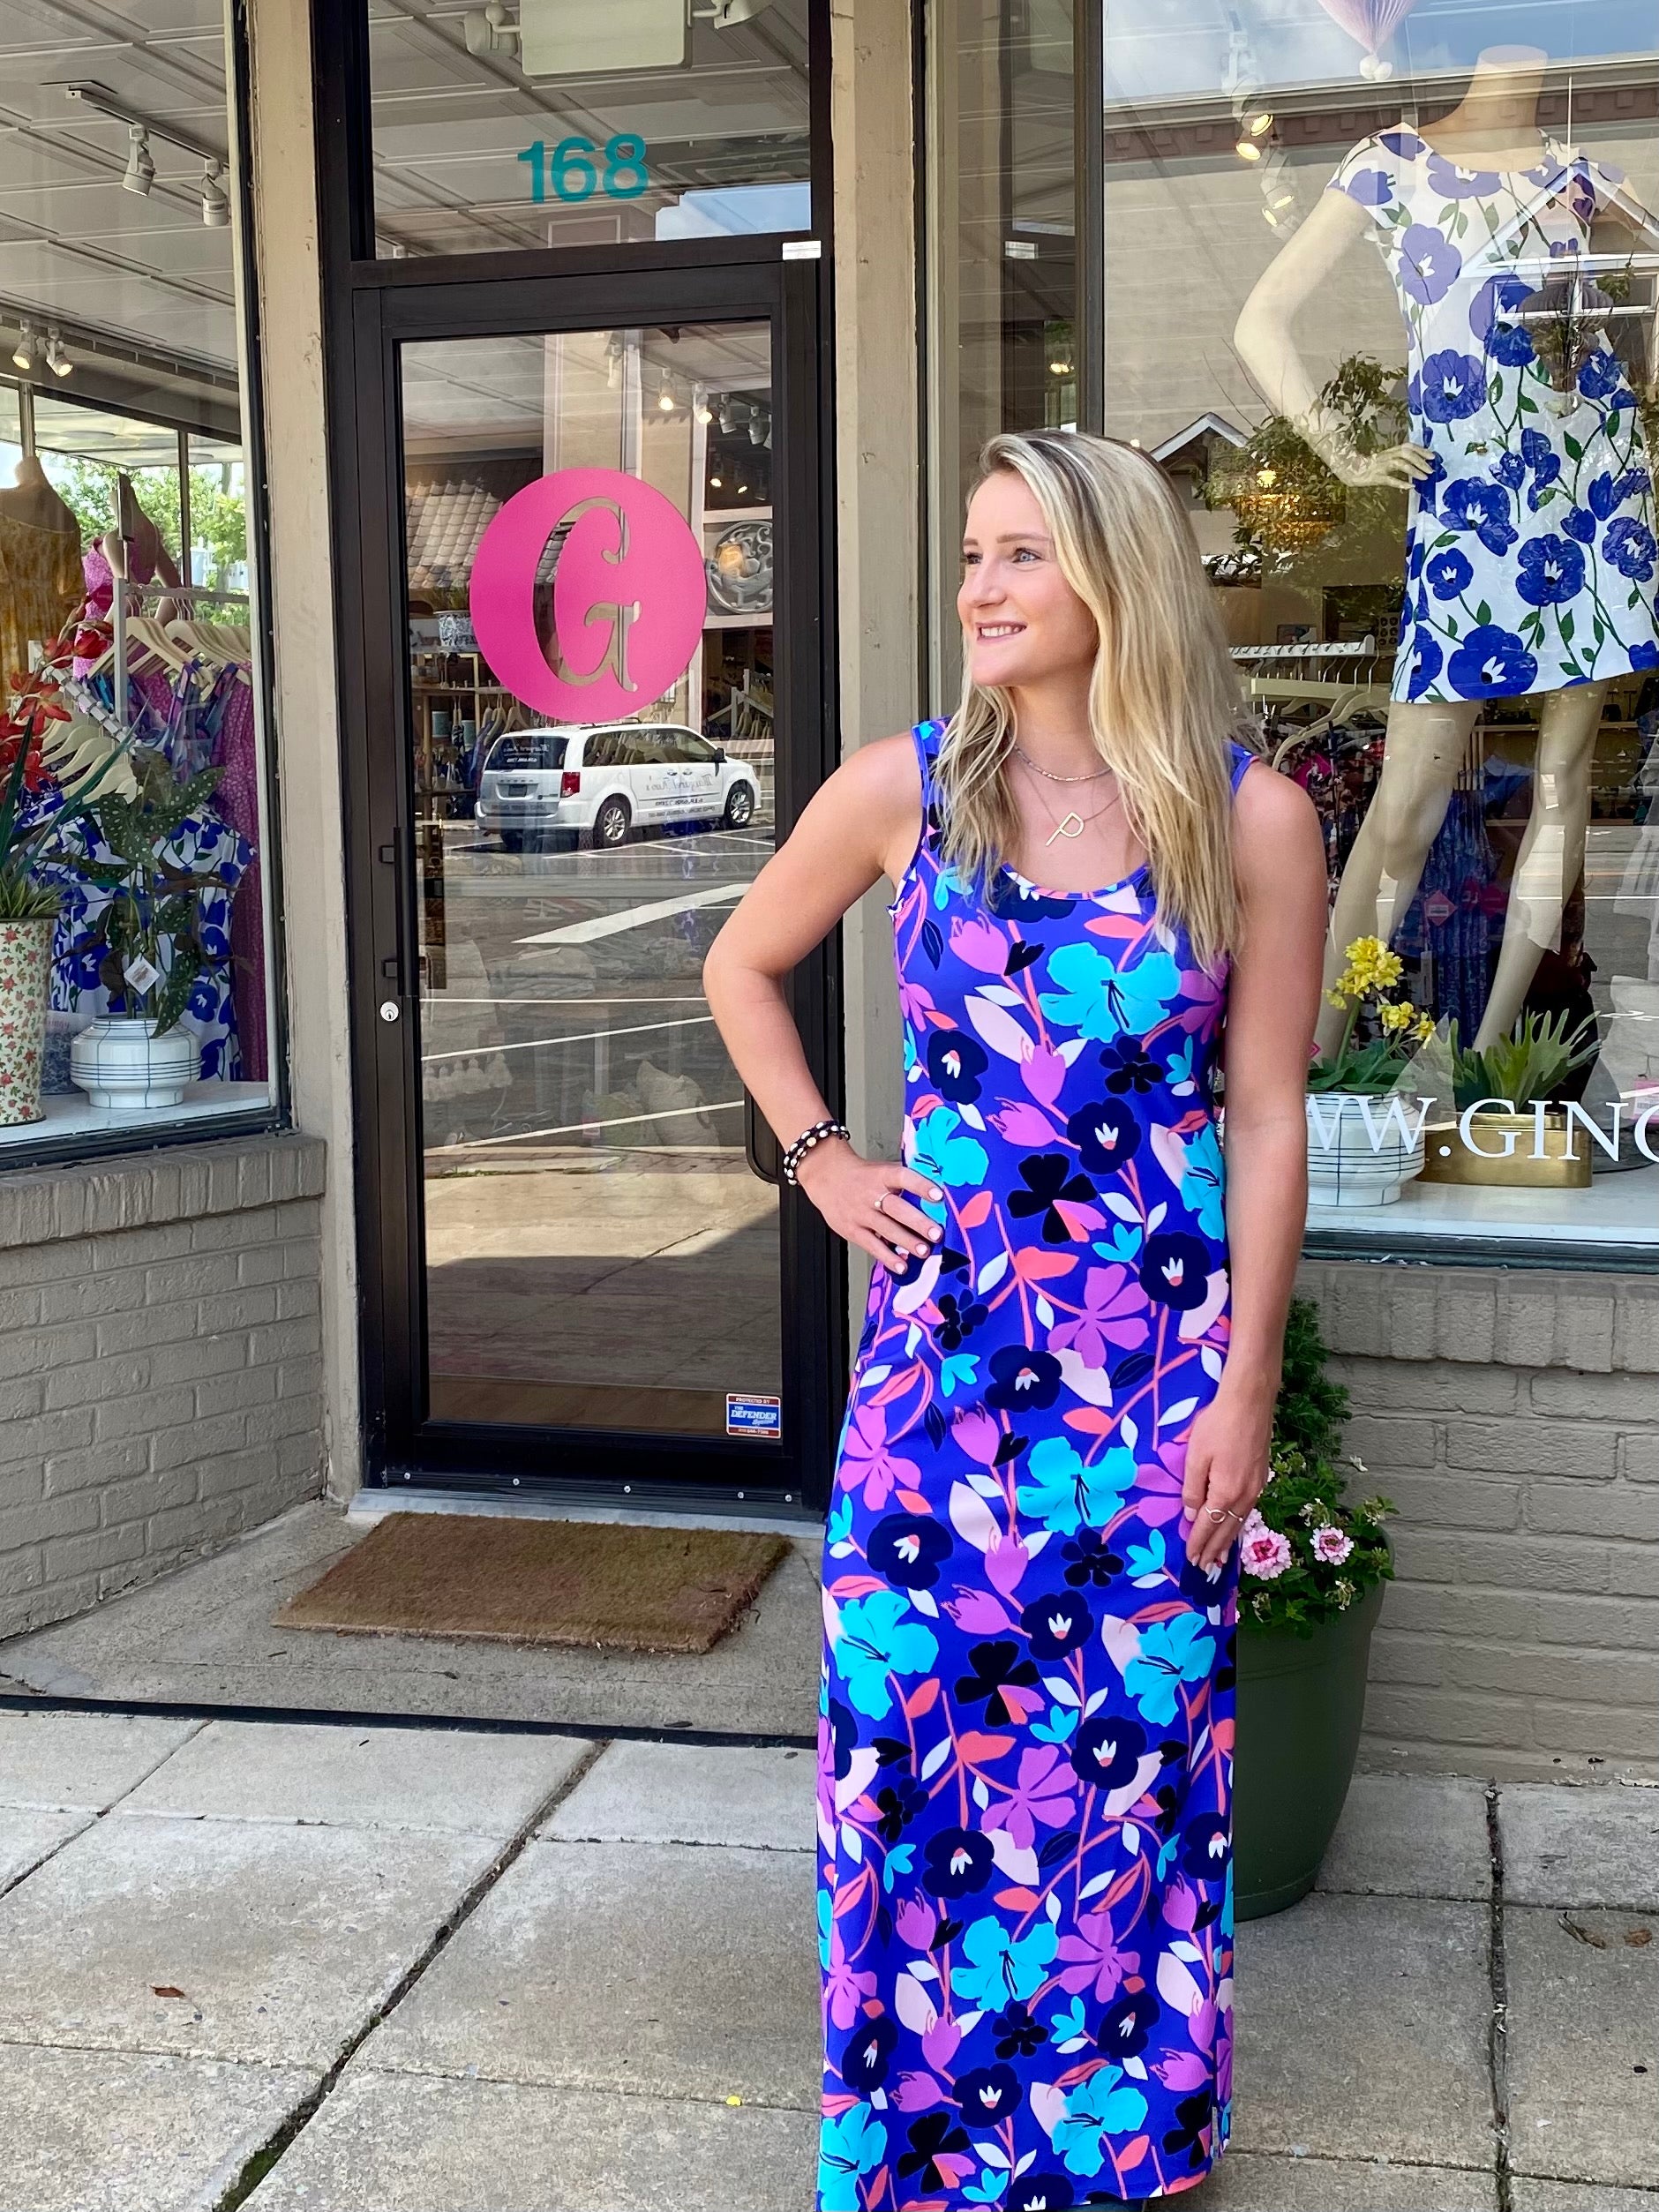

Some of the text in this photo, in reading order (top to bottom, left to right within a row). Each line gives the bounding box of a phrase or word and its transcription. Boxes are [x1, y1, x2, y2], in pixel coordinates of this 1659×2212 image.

[517, 133, 649, 204] 168
[532, 496, 641, 692] G
[731, 1410, 777, 1420] DEFENDER
